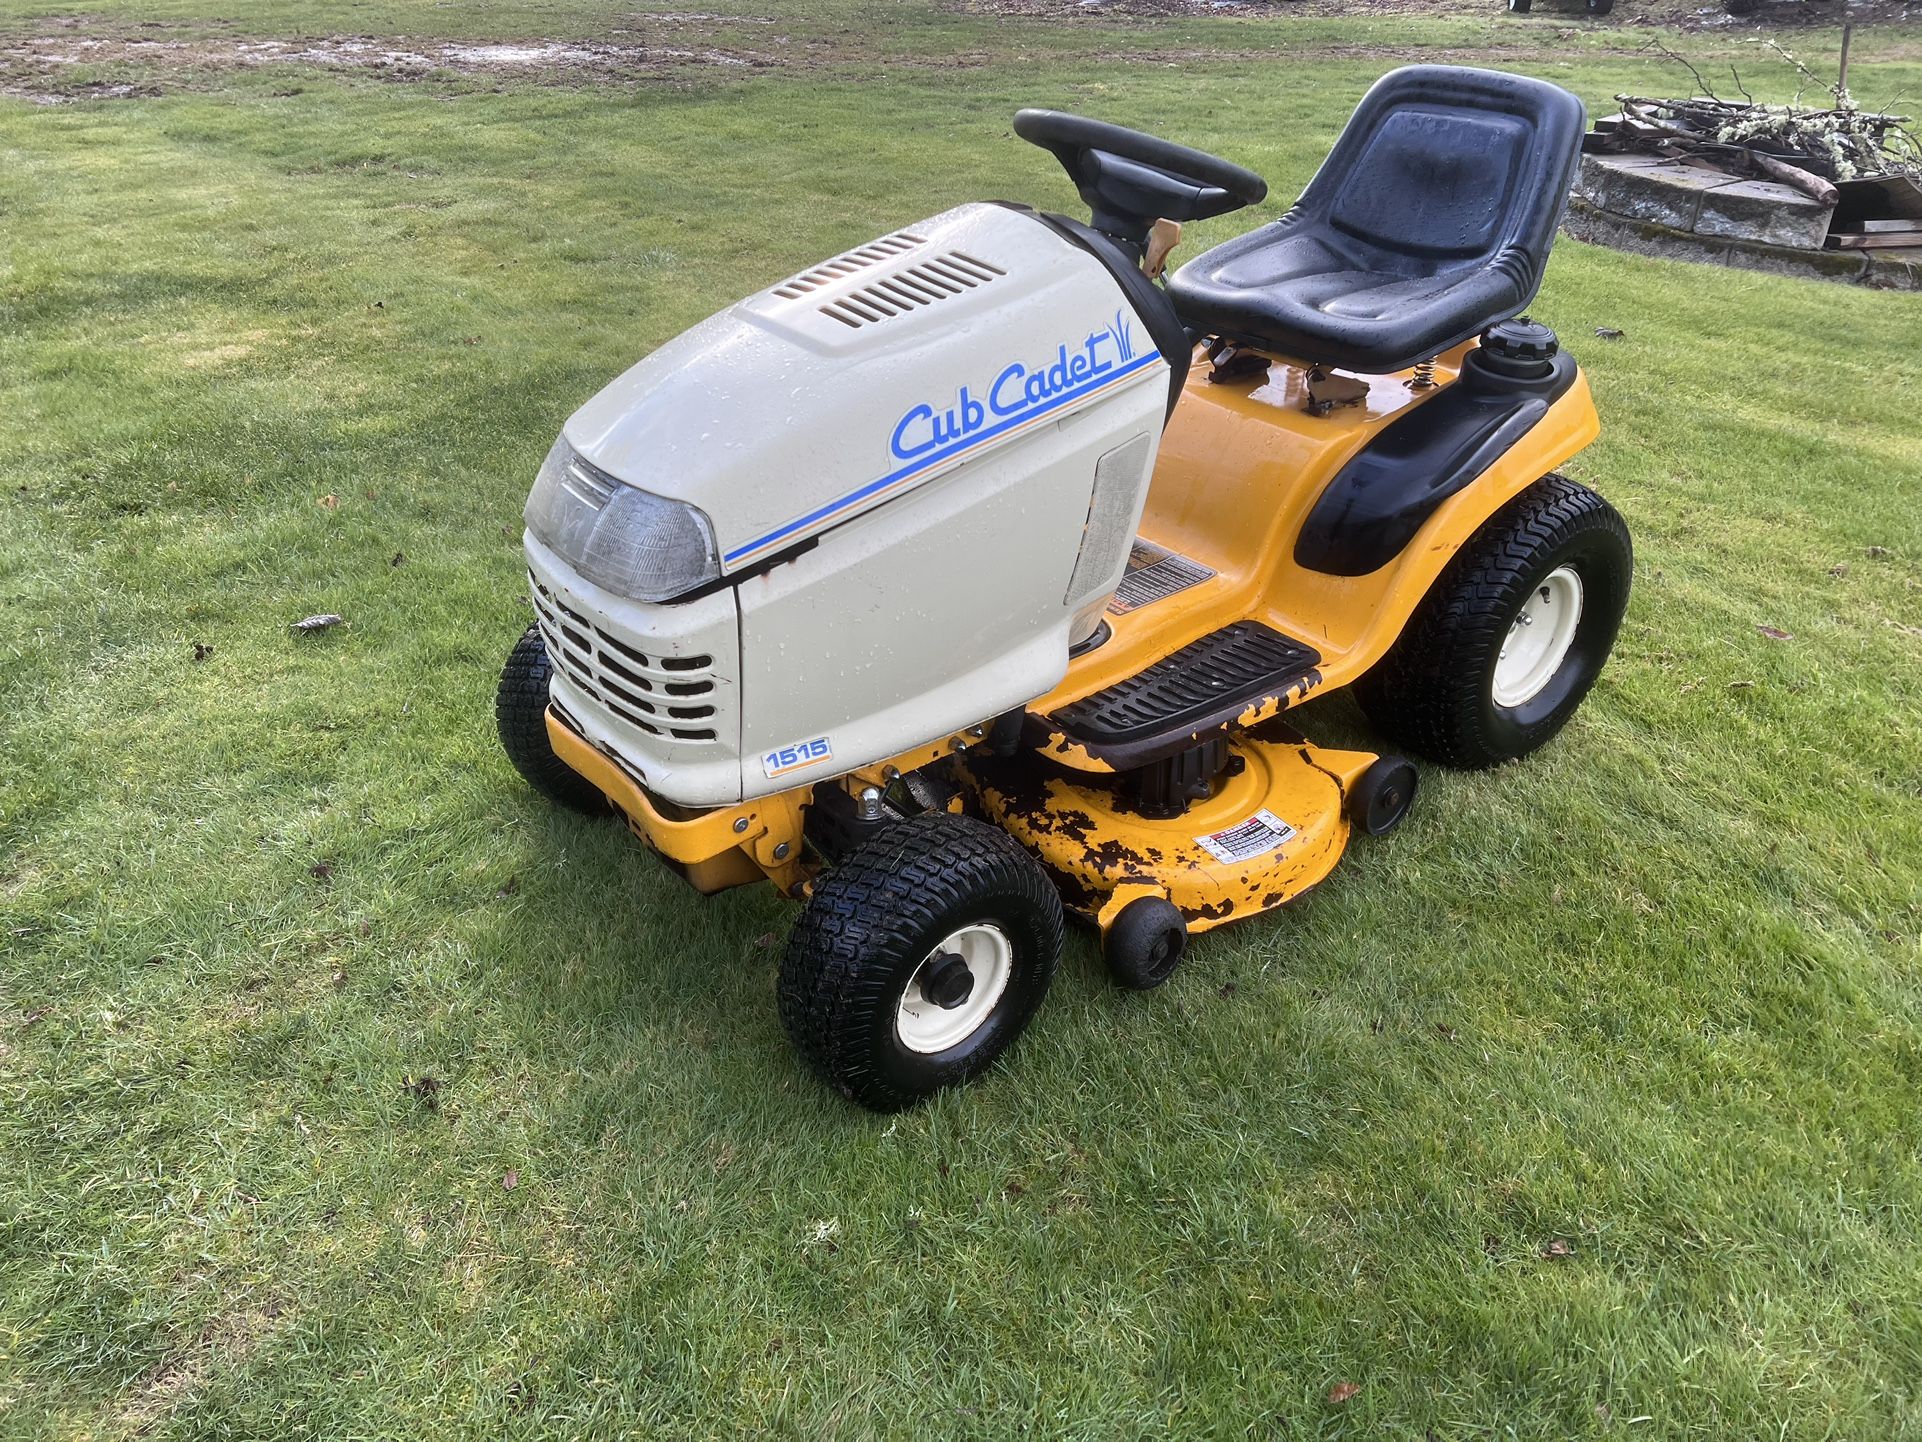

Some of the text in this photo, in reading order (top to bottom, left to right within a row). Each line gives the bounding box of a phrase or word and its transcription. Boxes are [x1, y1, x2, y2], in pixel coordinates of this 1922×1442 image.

[891, 332, 1112, 459] Cub Cadet
[766, 739, 828, 768] 1515
